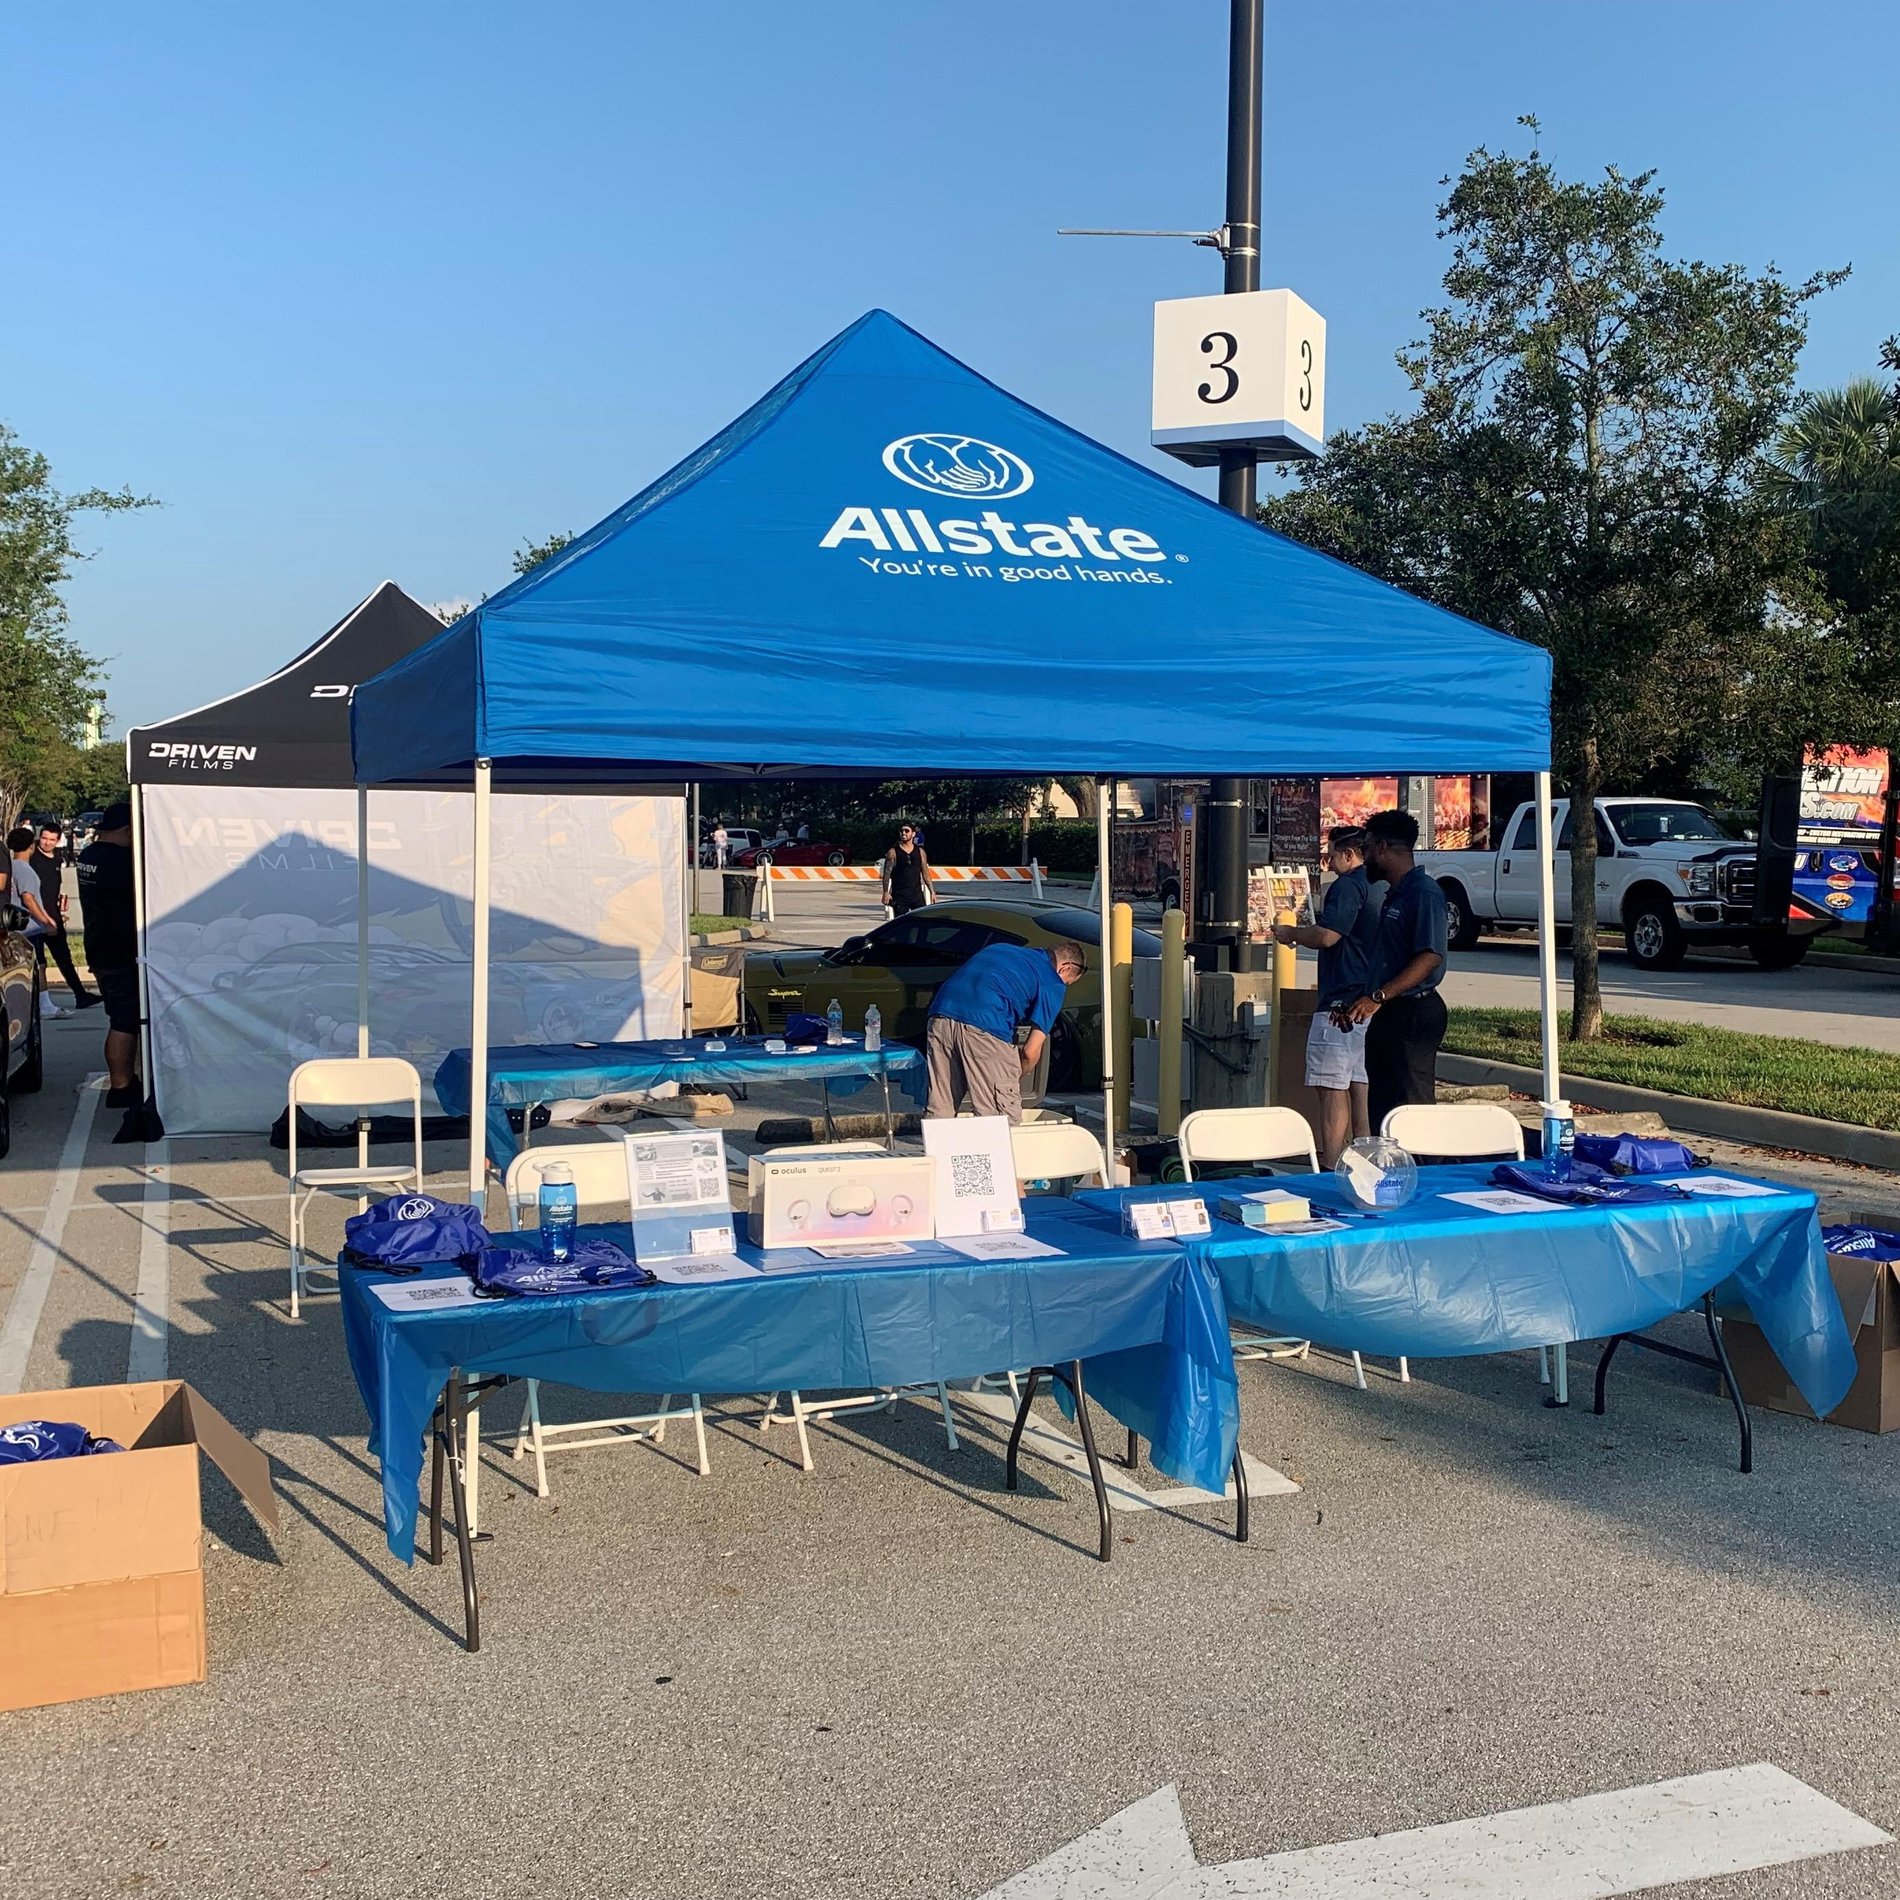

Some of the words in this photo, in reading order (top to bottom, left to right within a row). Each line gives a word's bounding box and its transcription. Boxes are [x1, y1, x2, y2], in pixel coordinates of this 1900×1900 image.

[1197, 331, 1239, 404] 3
[1299, 339, 1312, 411] 3
[818, 506, 1167, 562] Allstate
[859, 556, 956, 577] You're
[963, 561, 993, 579] in
[1000, 564, 1072, 583] good
[1075, 565, 1173, 584] hands.
[148, 742, 257, 761] DRIVEN
[168, 759, 234, 770] FILMS
[767, 988, 802, 999] Supra
[781, 1167, 807, 1175] oculus
